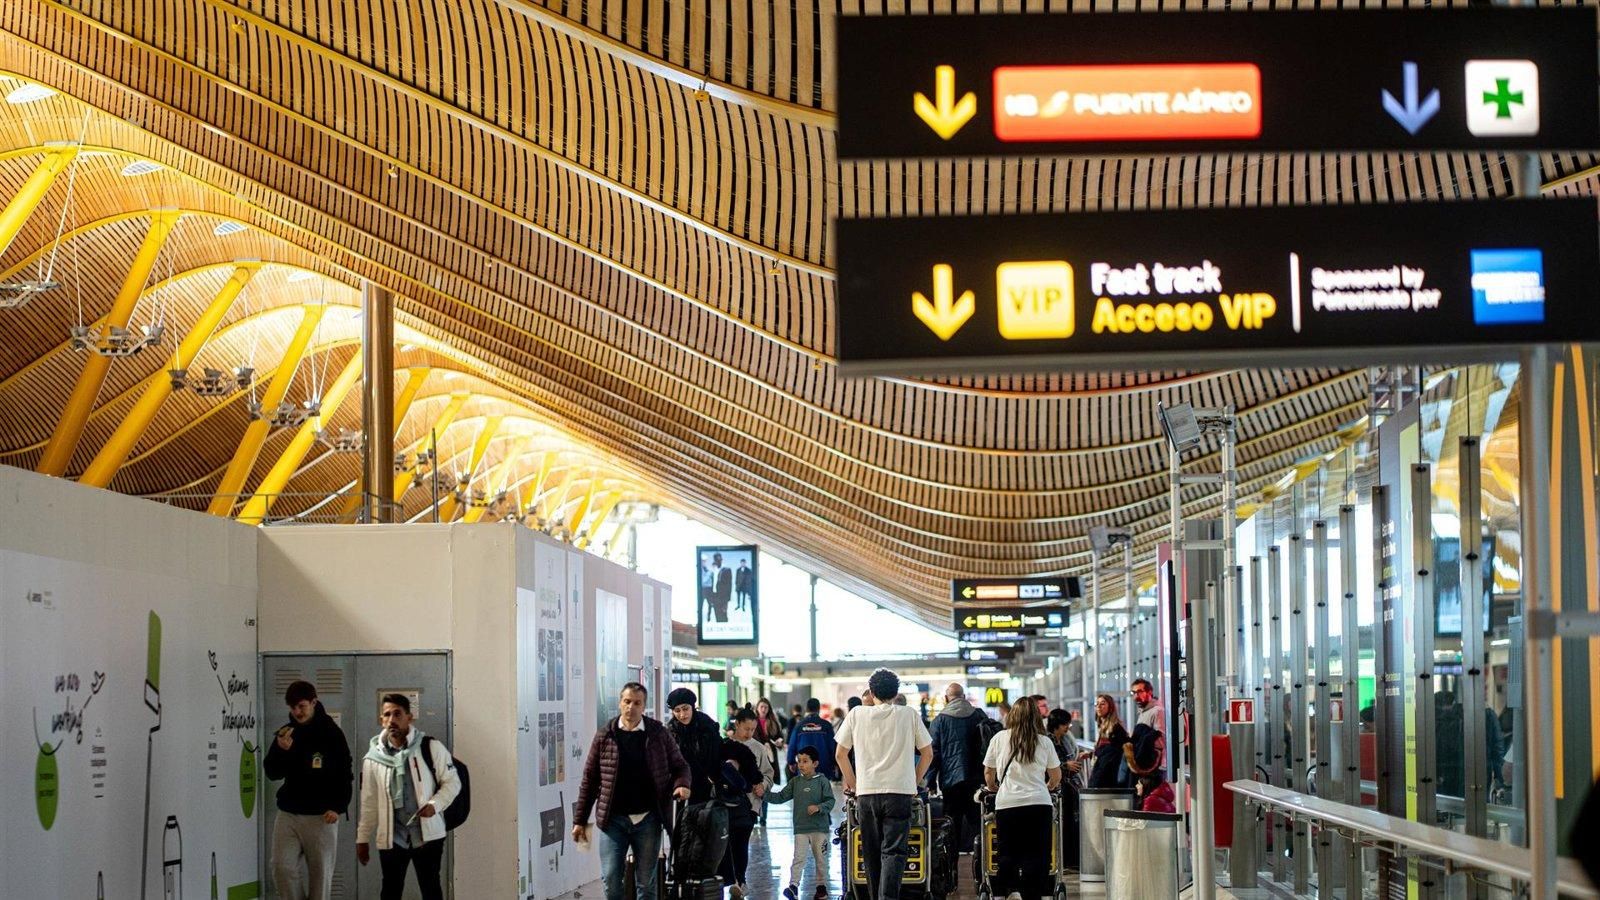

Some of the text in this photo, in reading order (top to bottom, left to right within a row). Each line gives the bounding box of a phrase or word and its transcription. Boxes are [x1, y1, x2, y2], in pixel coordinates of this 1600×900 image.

[1074, 92, 1169, 115] PUENTE
[1171, 88, 1252, 113] AÉREO
[1091, 260, 1222, 296] Fast track
[1311, 265, 1425, 291] Sponsored by
[1009, 288, 1061, 314] VIP
[1312, 288, 1442, 312] Patrocinado por
[1091, 293, 1276, 334] Acceso VIP
